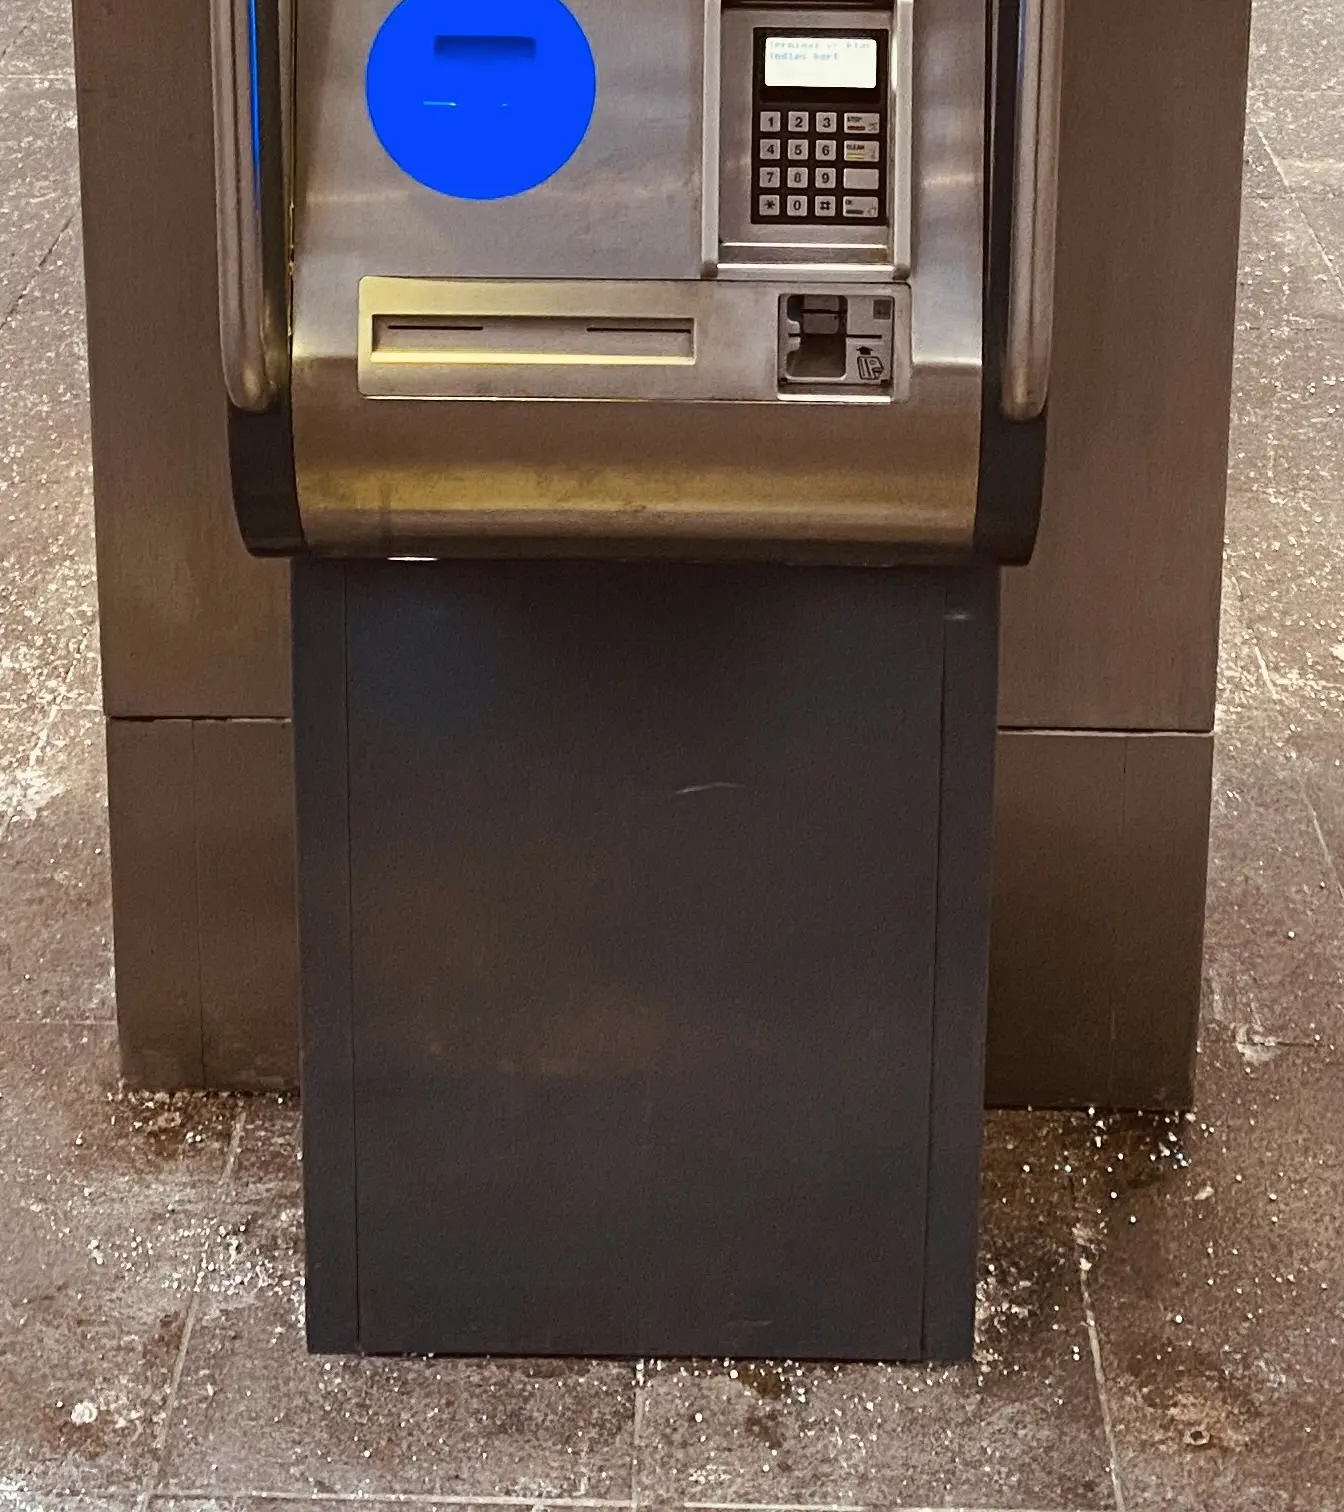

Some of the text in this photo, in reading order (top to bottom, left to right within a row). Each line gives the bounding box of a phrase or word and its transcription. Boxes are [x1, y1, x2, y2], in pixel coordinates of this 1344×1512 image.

[767, 117, 774, 128] 1
[794, 116, 803, 128] 2
[822, 117, 831, 128] 3
[766, 144, 775, 155] 4
[794, 144, 803, 156] 5
[821, 145, 830, 156] 6
[766, 172, 775, 183] 7
[793, 172, 802, 183] 8
[821, 172, 830, 184] 9
[793, 199, 802, 211] 0
